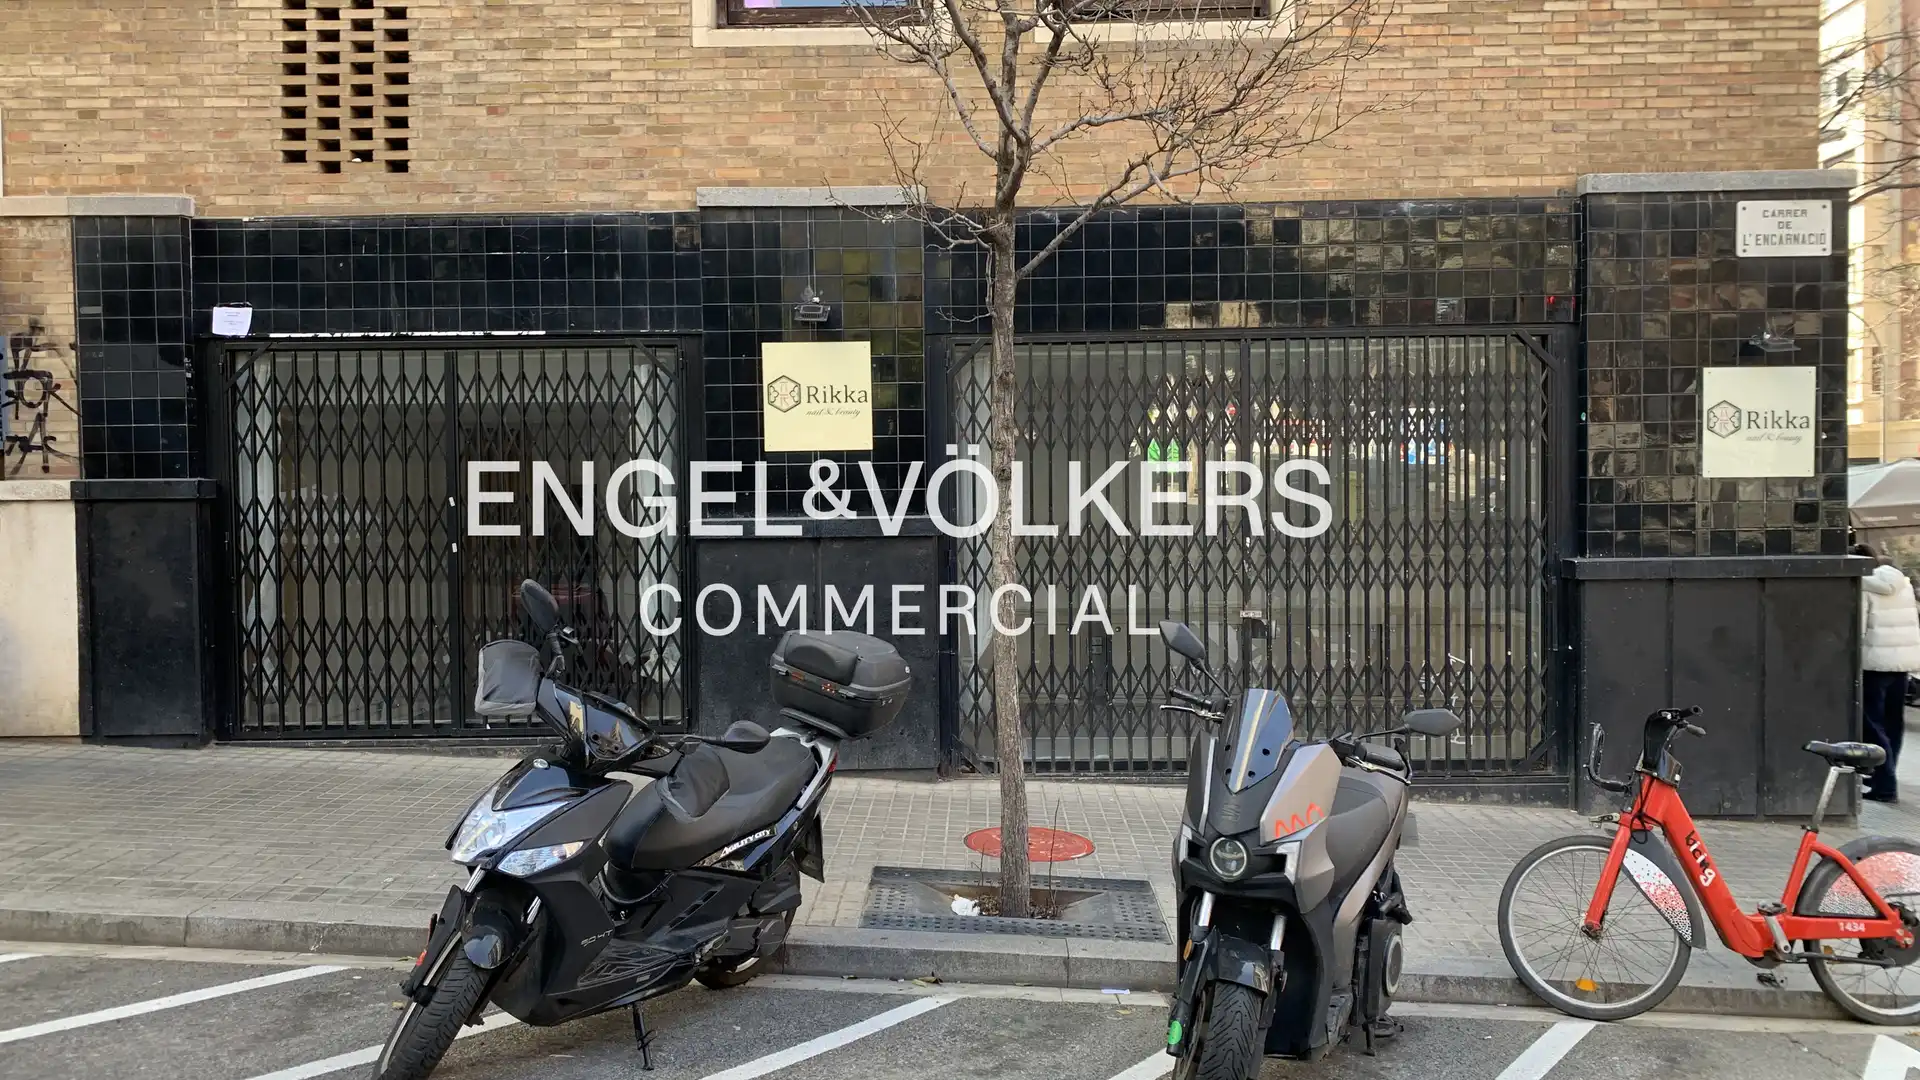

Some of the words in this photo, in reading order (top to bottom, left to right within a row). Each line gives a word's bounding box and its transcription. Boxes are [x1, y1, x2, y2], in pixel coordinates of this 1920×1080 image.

[1762, 209, 1808, 218] CARRER
[1777, 221, 1793, 230] DE
[806, 384, 869, 404] Rikka
[805, 408, 824, 417] nail
[835, 408, 861, 420] beauty
[1746, 409, 1811, 430] Rikka
[720, 834, 756, 858] AGILITY
[754, 828, 771, 839] CITY
[1839, 921, 1866, 932] 1434
